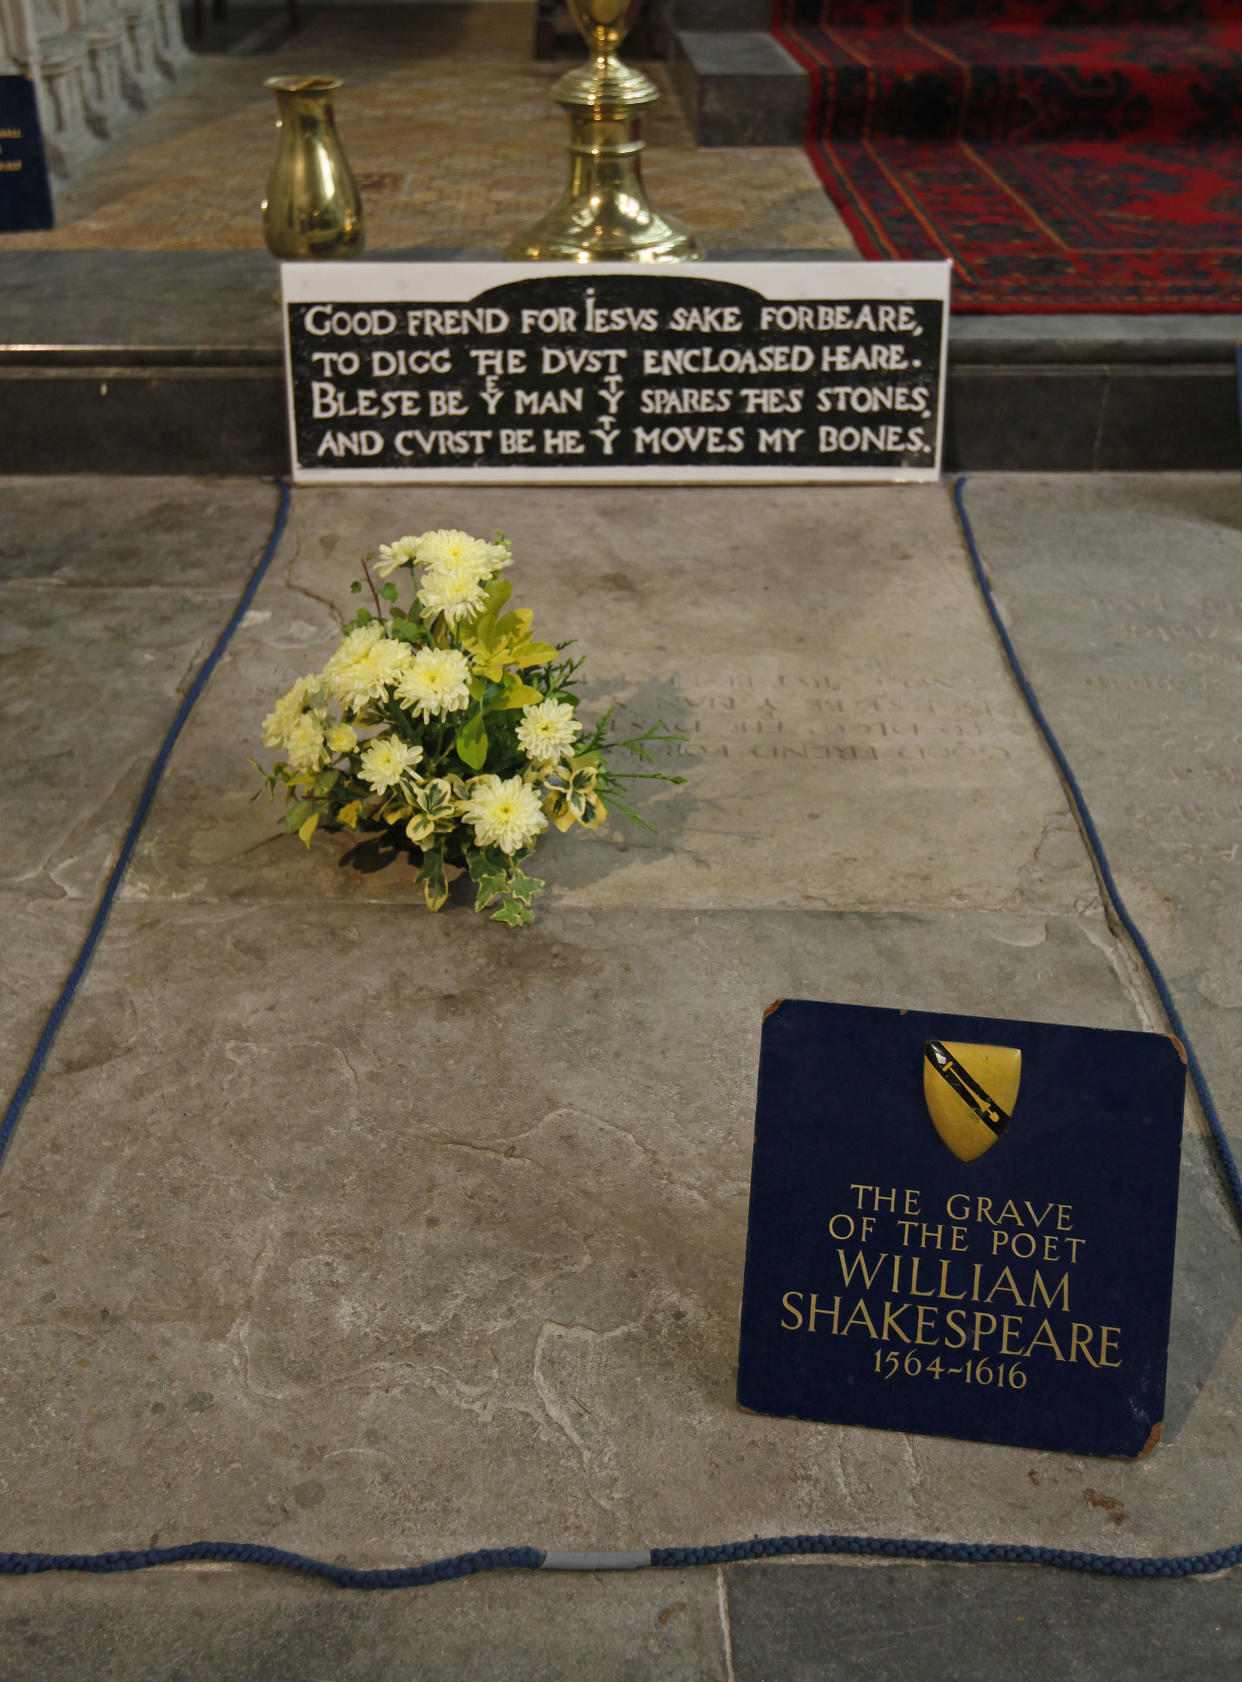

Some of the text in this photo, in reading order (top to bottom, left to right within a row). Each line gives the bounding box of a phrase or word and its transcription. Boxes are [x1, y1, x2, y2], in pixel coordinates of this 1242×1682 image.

[304, 304, 397, 336] GOOD
[407, 307, 511, 336] FREND
[521, 307, 577, 334] FOR
[669, 306, 743, 333] SAKE
[760, 305, 924, 337] FORBEARE,
[311, 351, 360, 377] TO
[541, 347, 628, 374] DVST
[643, 346, 815, 376] ENCLOASED
[311, 381, 421, 418] BLESE
[429, 390, 469, 417] BE
[515, 388, 583, 416] MAN
[640, 388, 732, 414] SPARES
[740, 389, 804, 414] THES
[317, 430, 384, 457] AND
[394, 430, 493, 456] CVRST
[499, 429, 536, 454] BE
[544, 430, 585, 455] HE
[634, 426, 745, 454] MOVES
[757, 428, 804, 452] MY
[819, 426, 931, 454] BONES.
[850, 1184, 1073, 1231] THE GRAVE
[828, 1214, 1087, 1264] OF THE POET
[835, 1248, 1071, 1312] WILLIAM
[780, 1291, 1123, 1368] SHAKESPEARE
